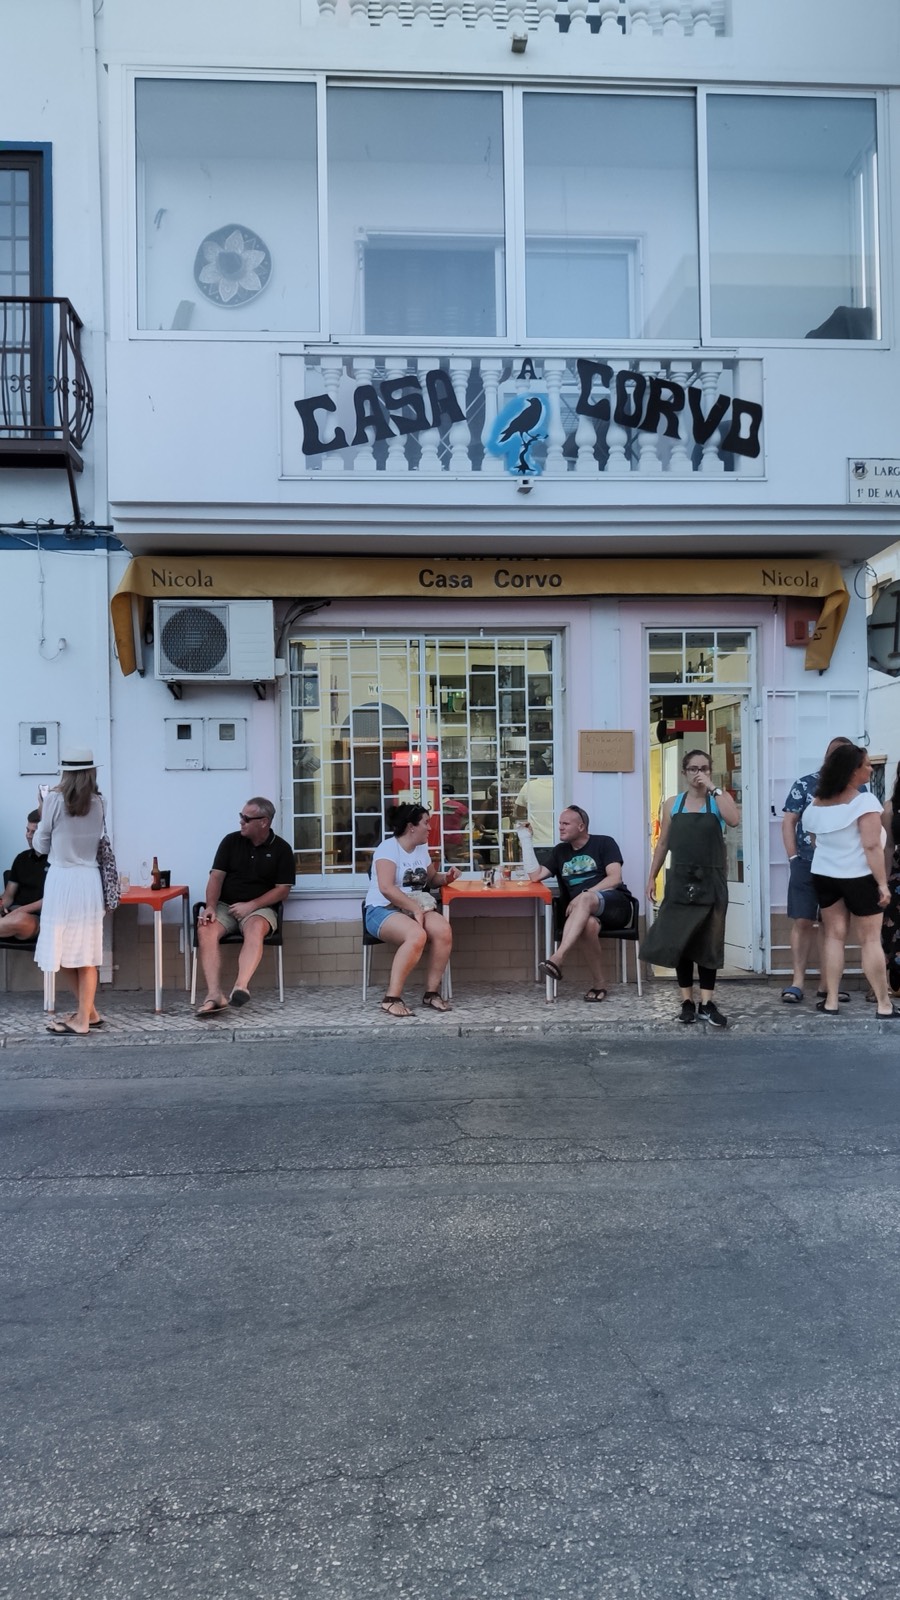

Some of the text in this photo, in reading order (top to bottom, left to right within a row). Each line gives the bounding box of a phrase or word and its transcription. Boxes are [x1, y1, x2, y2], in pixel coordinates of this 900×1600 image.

[295, 370, 467, 456] CASA
[576, 358, 764, 458] CORVO
[868, 488, 880, 498] DE
[151, 568, 213, 587] Nicola
[418, 568, 562, 588] Casa Corvo
[761, 569, 819, 588] Nicola
